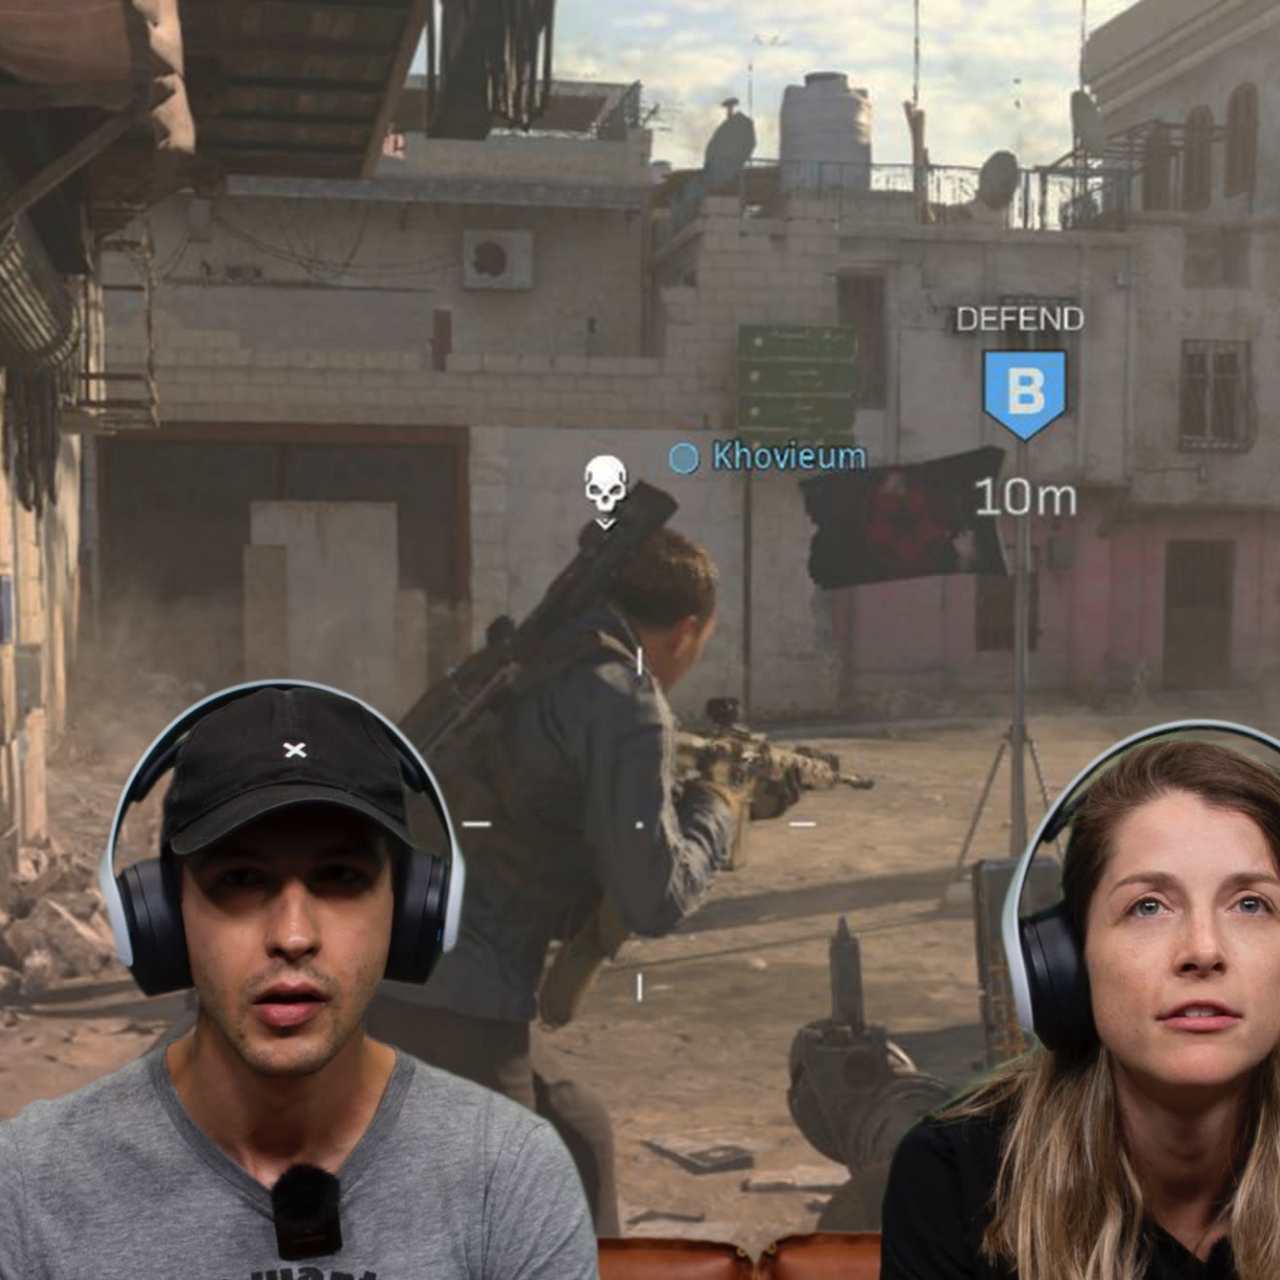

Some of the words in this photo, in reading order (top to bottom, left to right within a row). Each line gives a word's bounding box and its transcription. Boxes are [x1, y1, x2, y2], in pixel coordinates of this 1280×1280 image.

[957, 306, 1085, 333] DEFEND
[1007, 367, 1046, 416] B
[713, 440, 866, 470] Khovieum
[975, 477, 1078, 517] 10m
